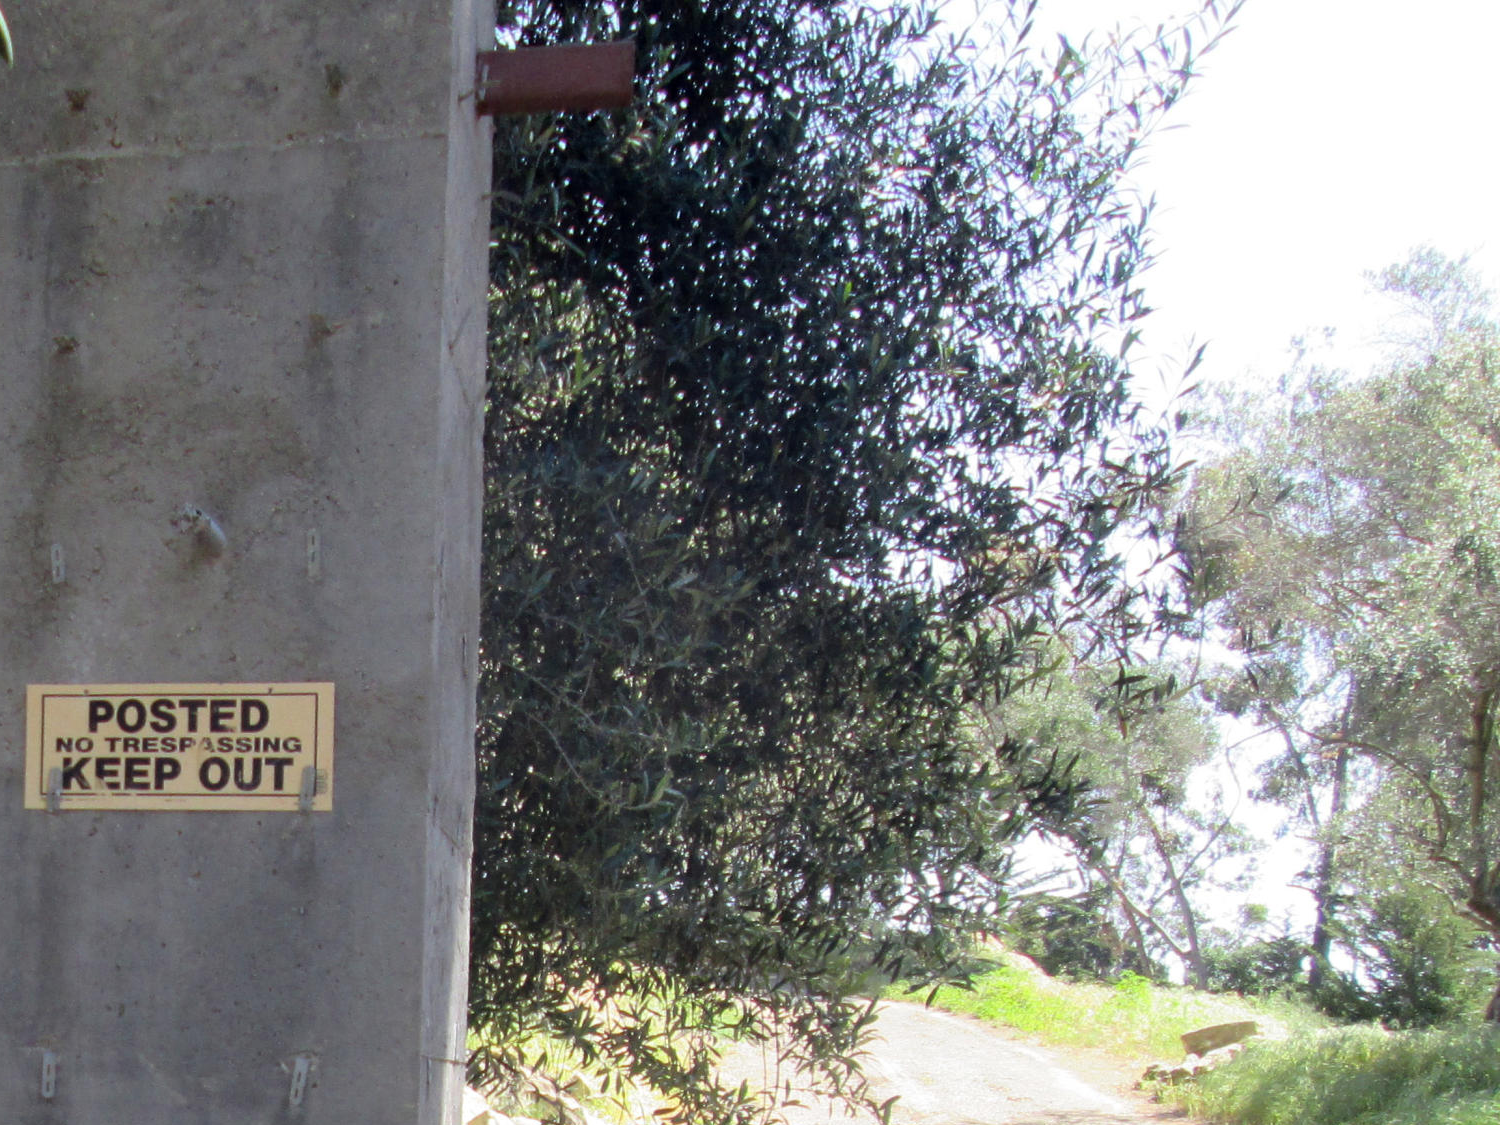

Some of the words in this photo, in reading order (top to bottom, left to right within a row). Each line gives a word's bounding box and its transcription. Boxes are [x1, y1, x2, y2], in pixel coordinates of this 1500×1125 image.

[88, 699, 270, 733] POSTED
[56, 737, 94, 753] NO
[62, 756, 182, 791] KEEP
[198, 756, 294, 792] OUT
